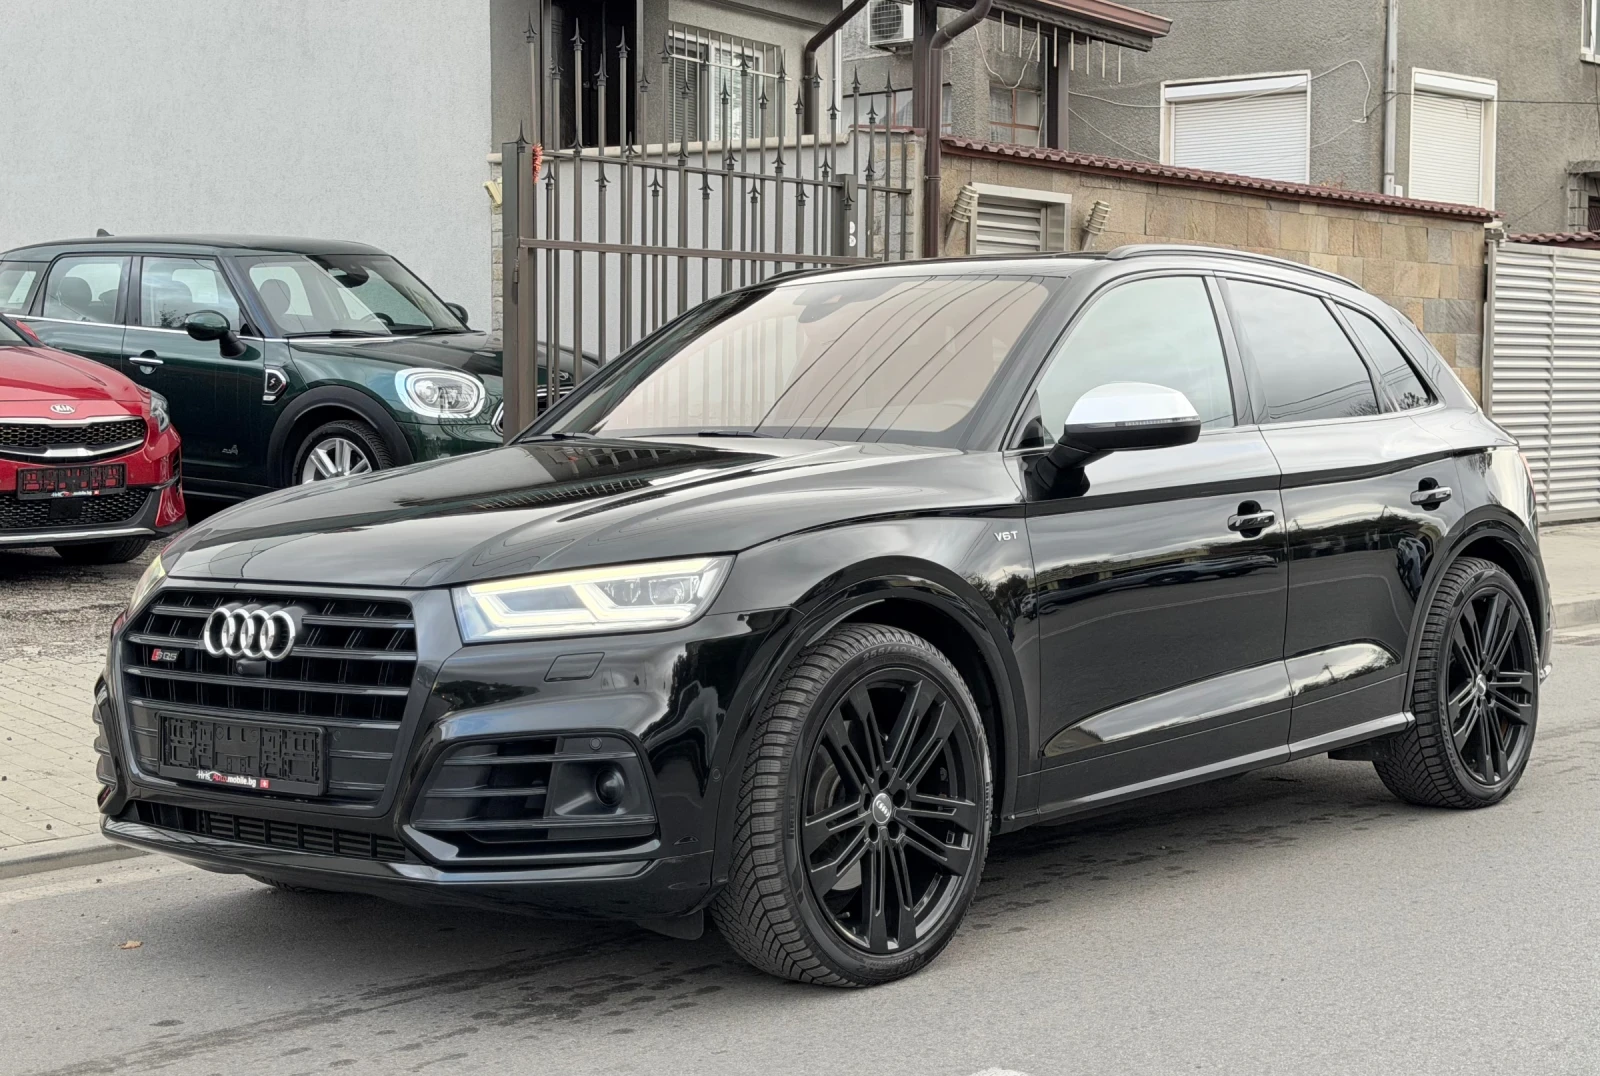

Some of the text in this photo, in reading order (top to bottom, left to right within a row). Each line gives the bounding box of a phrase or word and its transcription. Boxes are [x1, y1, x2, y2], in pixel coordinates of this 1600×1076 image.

[53, 404, 74, 413] KIA
[993, 531, 1018, 542] V6T
[151, 648, 177, 661] SQ5
